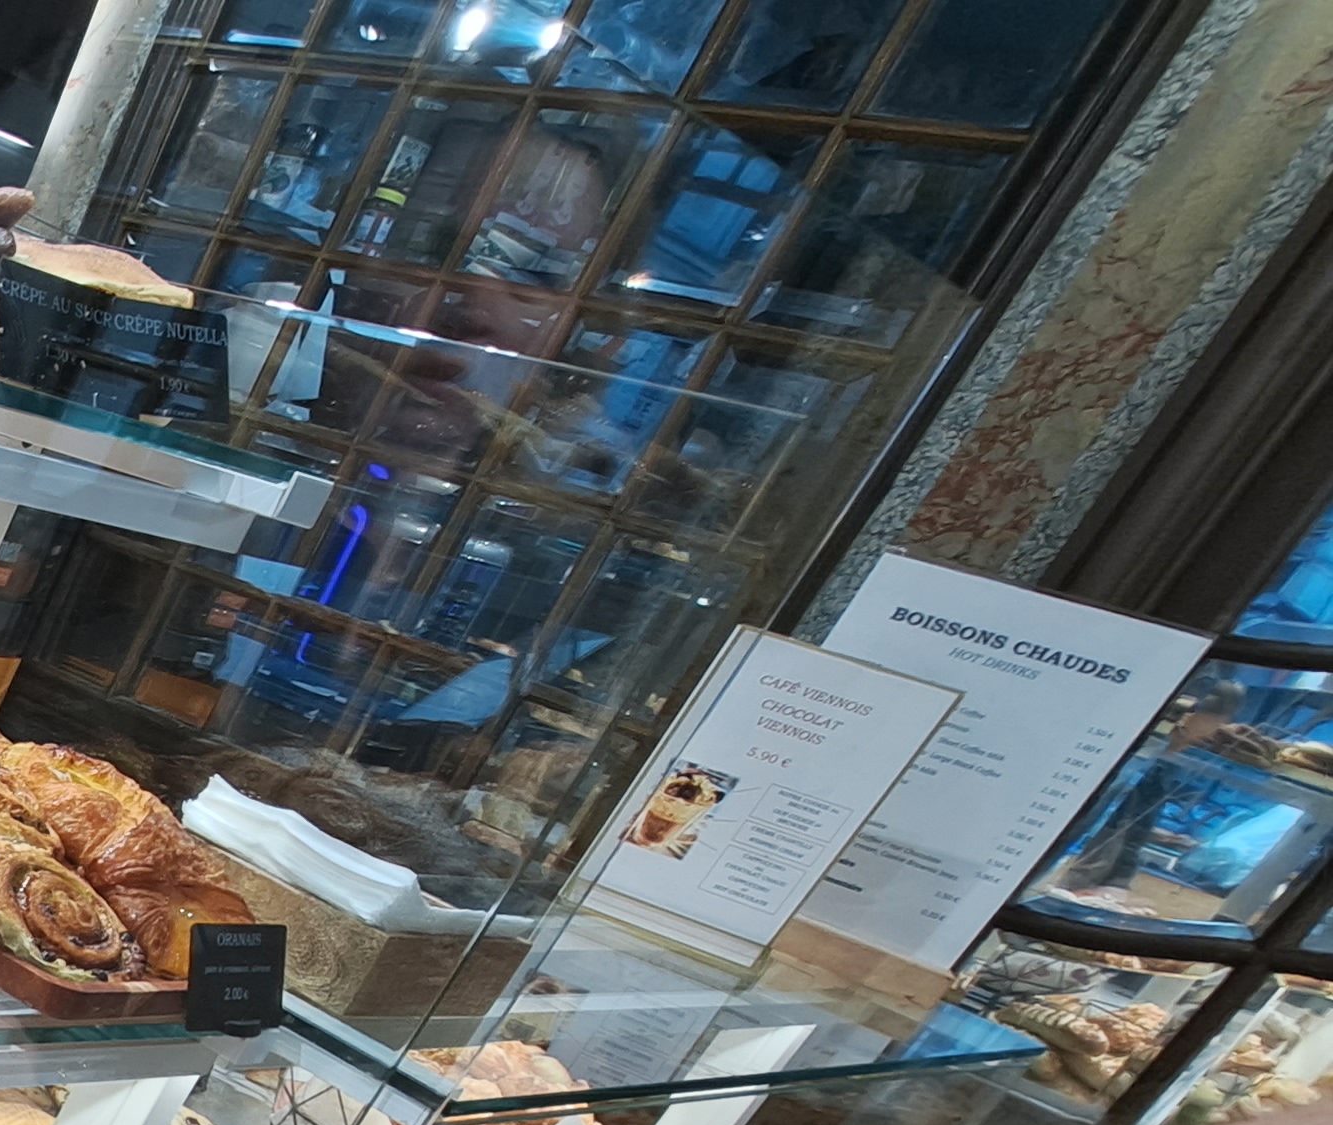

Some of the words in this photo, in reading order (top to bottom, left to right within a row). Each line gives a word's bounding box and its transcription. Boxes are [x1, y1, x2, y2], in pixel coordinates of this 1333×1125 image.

[52, 297, 71, 314] AU
[75, 303, 112, 327] SUCR
[166, 322, 228, 346] NUTELLA
[890, 606, 1008, 650] BOISSONS
[1013, 641, 1131, 684] CHAUDES
[948, 647, 984, 663] HOT
[982, 657, 1041, 680] DRINKS
[759, 675, 801, 694] CAFÉ
[803, 687, 873, 716] VIENNOIS
[761, 699, 844, 730] CHOCOLAT
[757, 716, 826, 745] VIENNOIS
[747, 747, 778, 764] 5.90
[781, 758, 792, 768] €
[217, 933, 262, 946] ORANAIS
[224, 987, 243, 1000] 2.00
